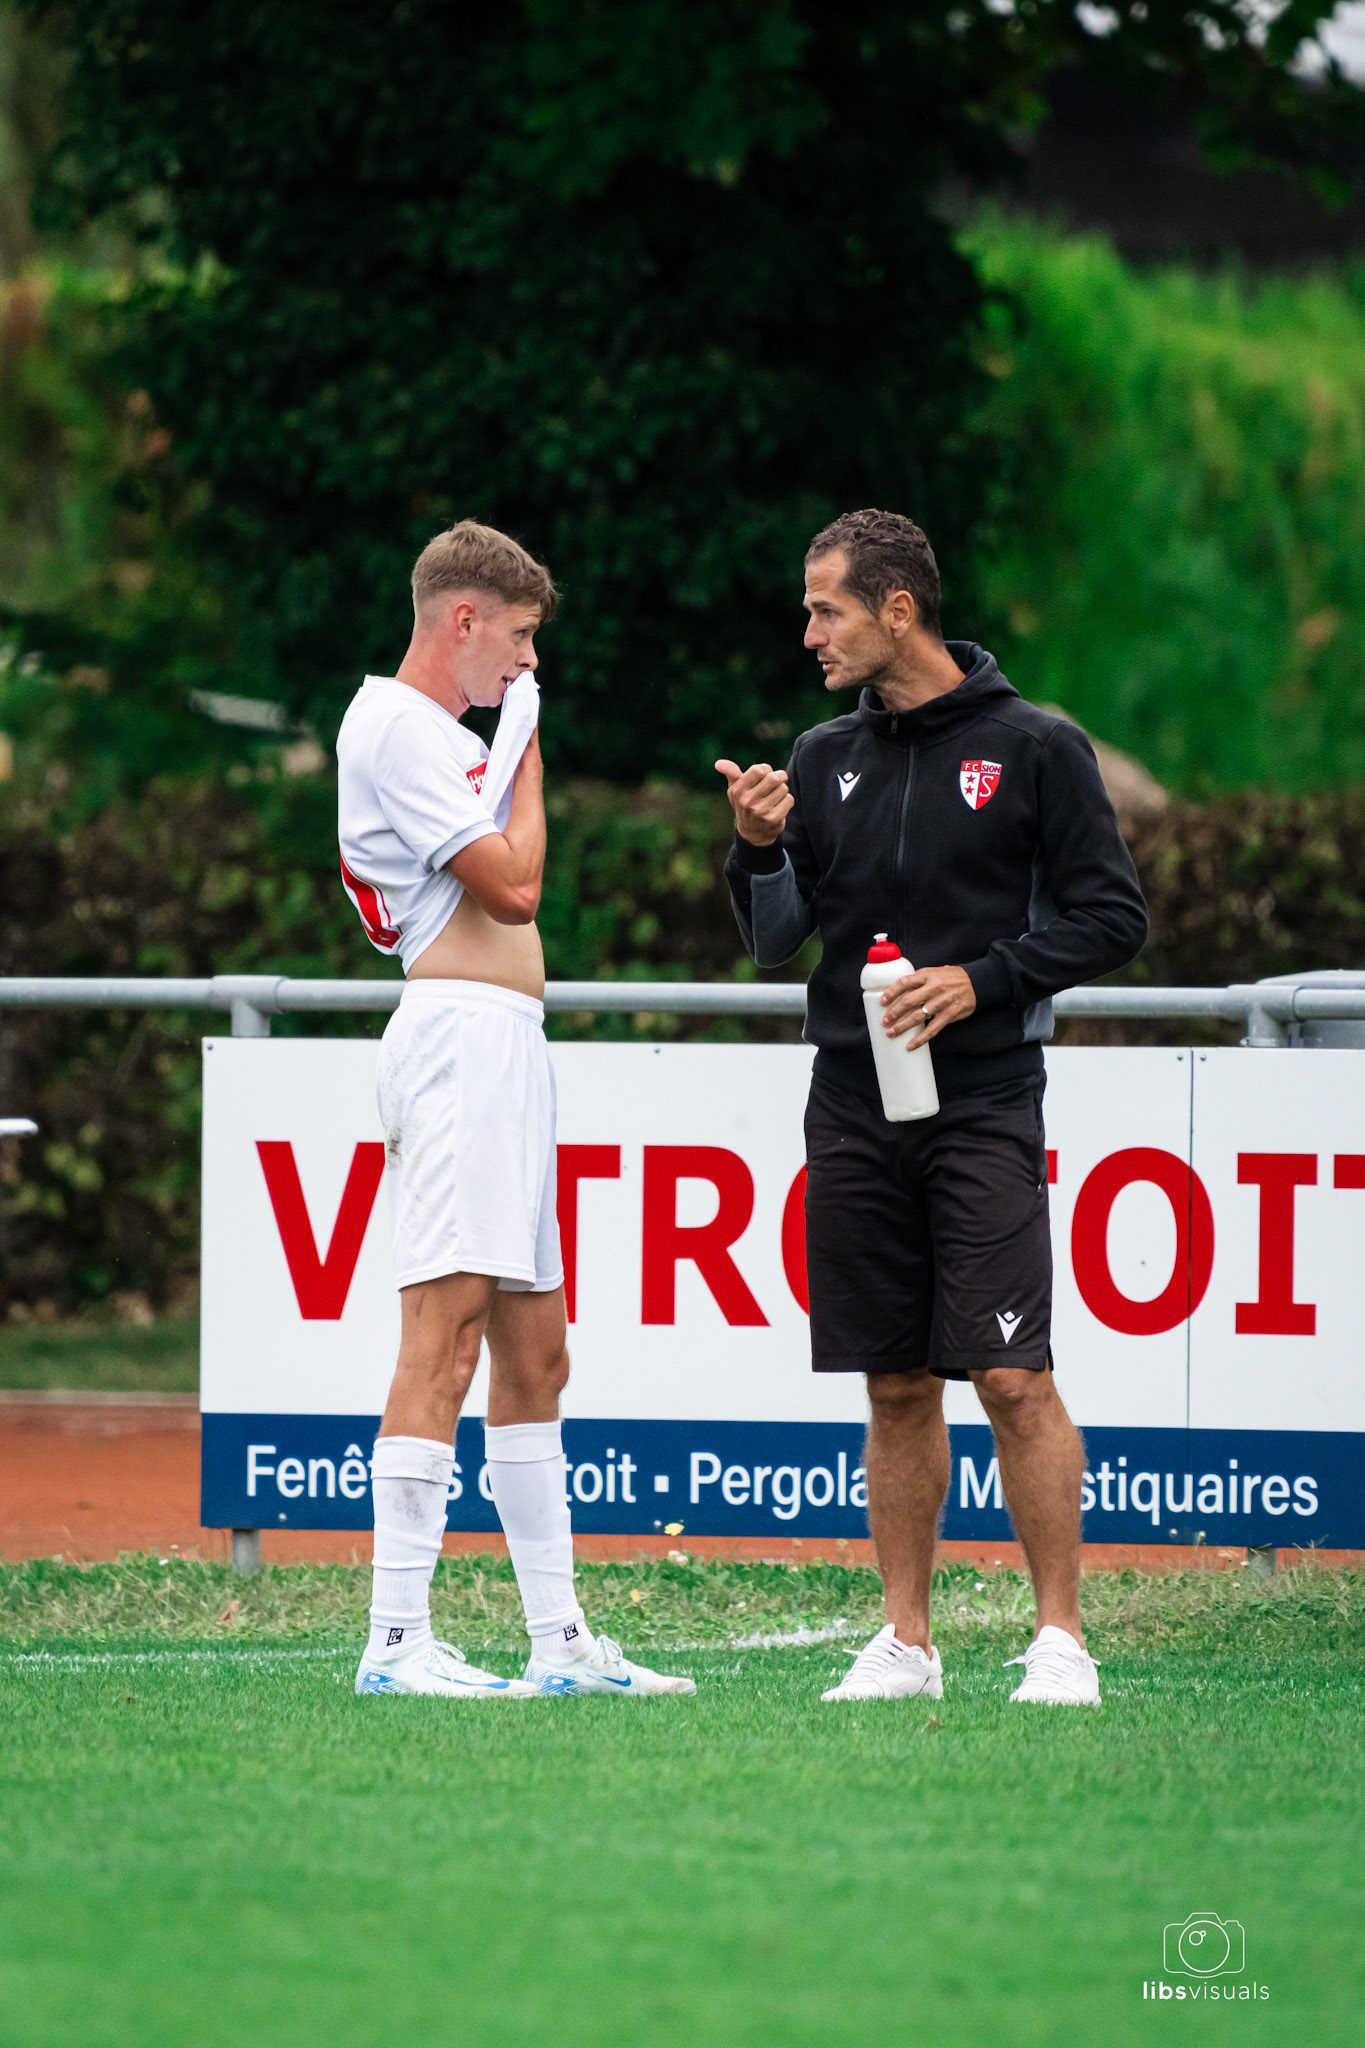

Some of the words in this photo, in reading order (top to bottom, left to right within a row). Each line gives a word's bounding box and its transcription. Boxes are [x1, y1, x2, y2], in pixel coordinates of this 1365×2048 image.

[246, 1444, 463, 1502] Fenês
[690, 1452, 869, 1520] Pergola
[960, 1457, 1319, 1526] Mstiquaires
